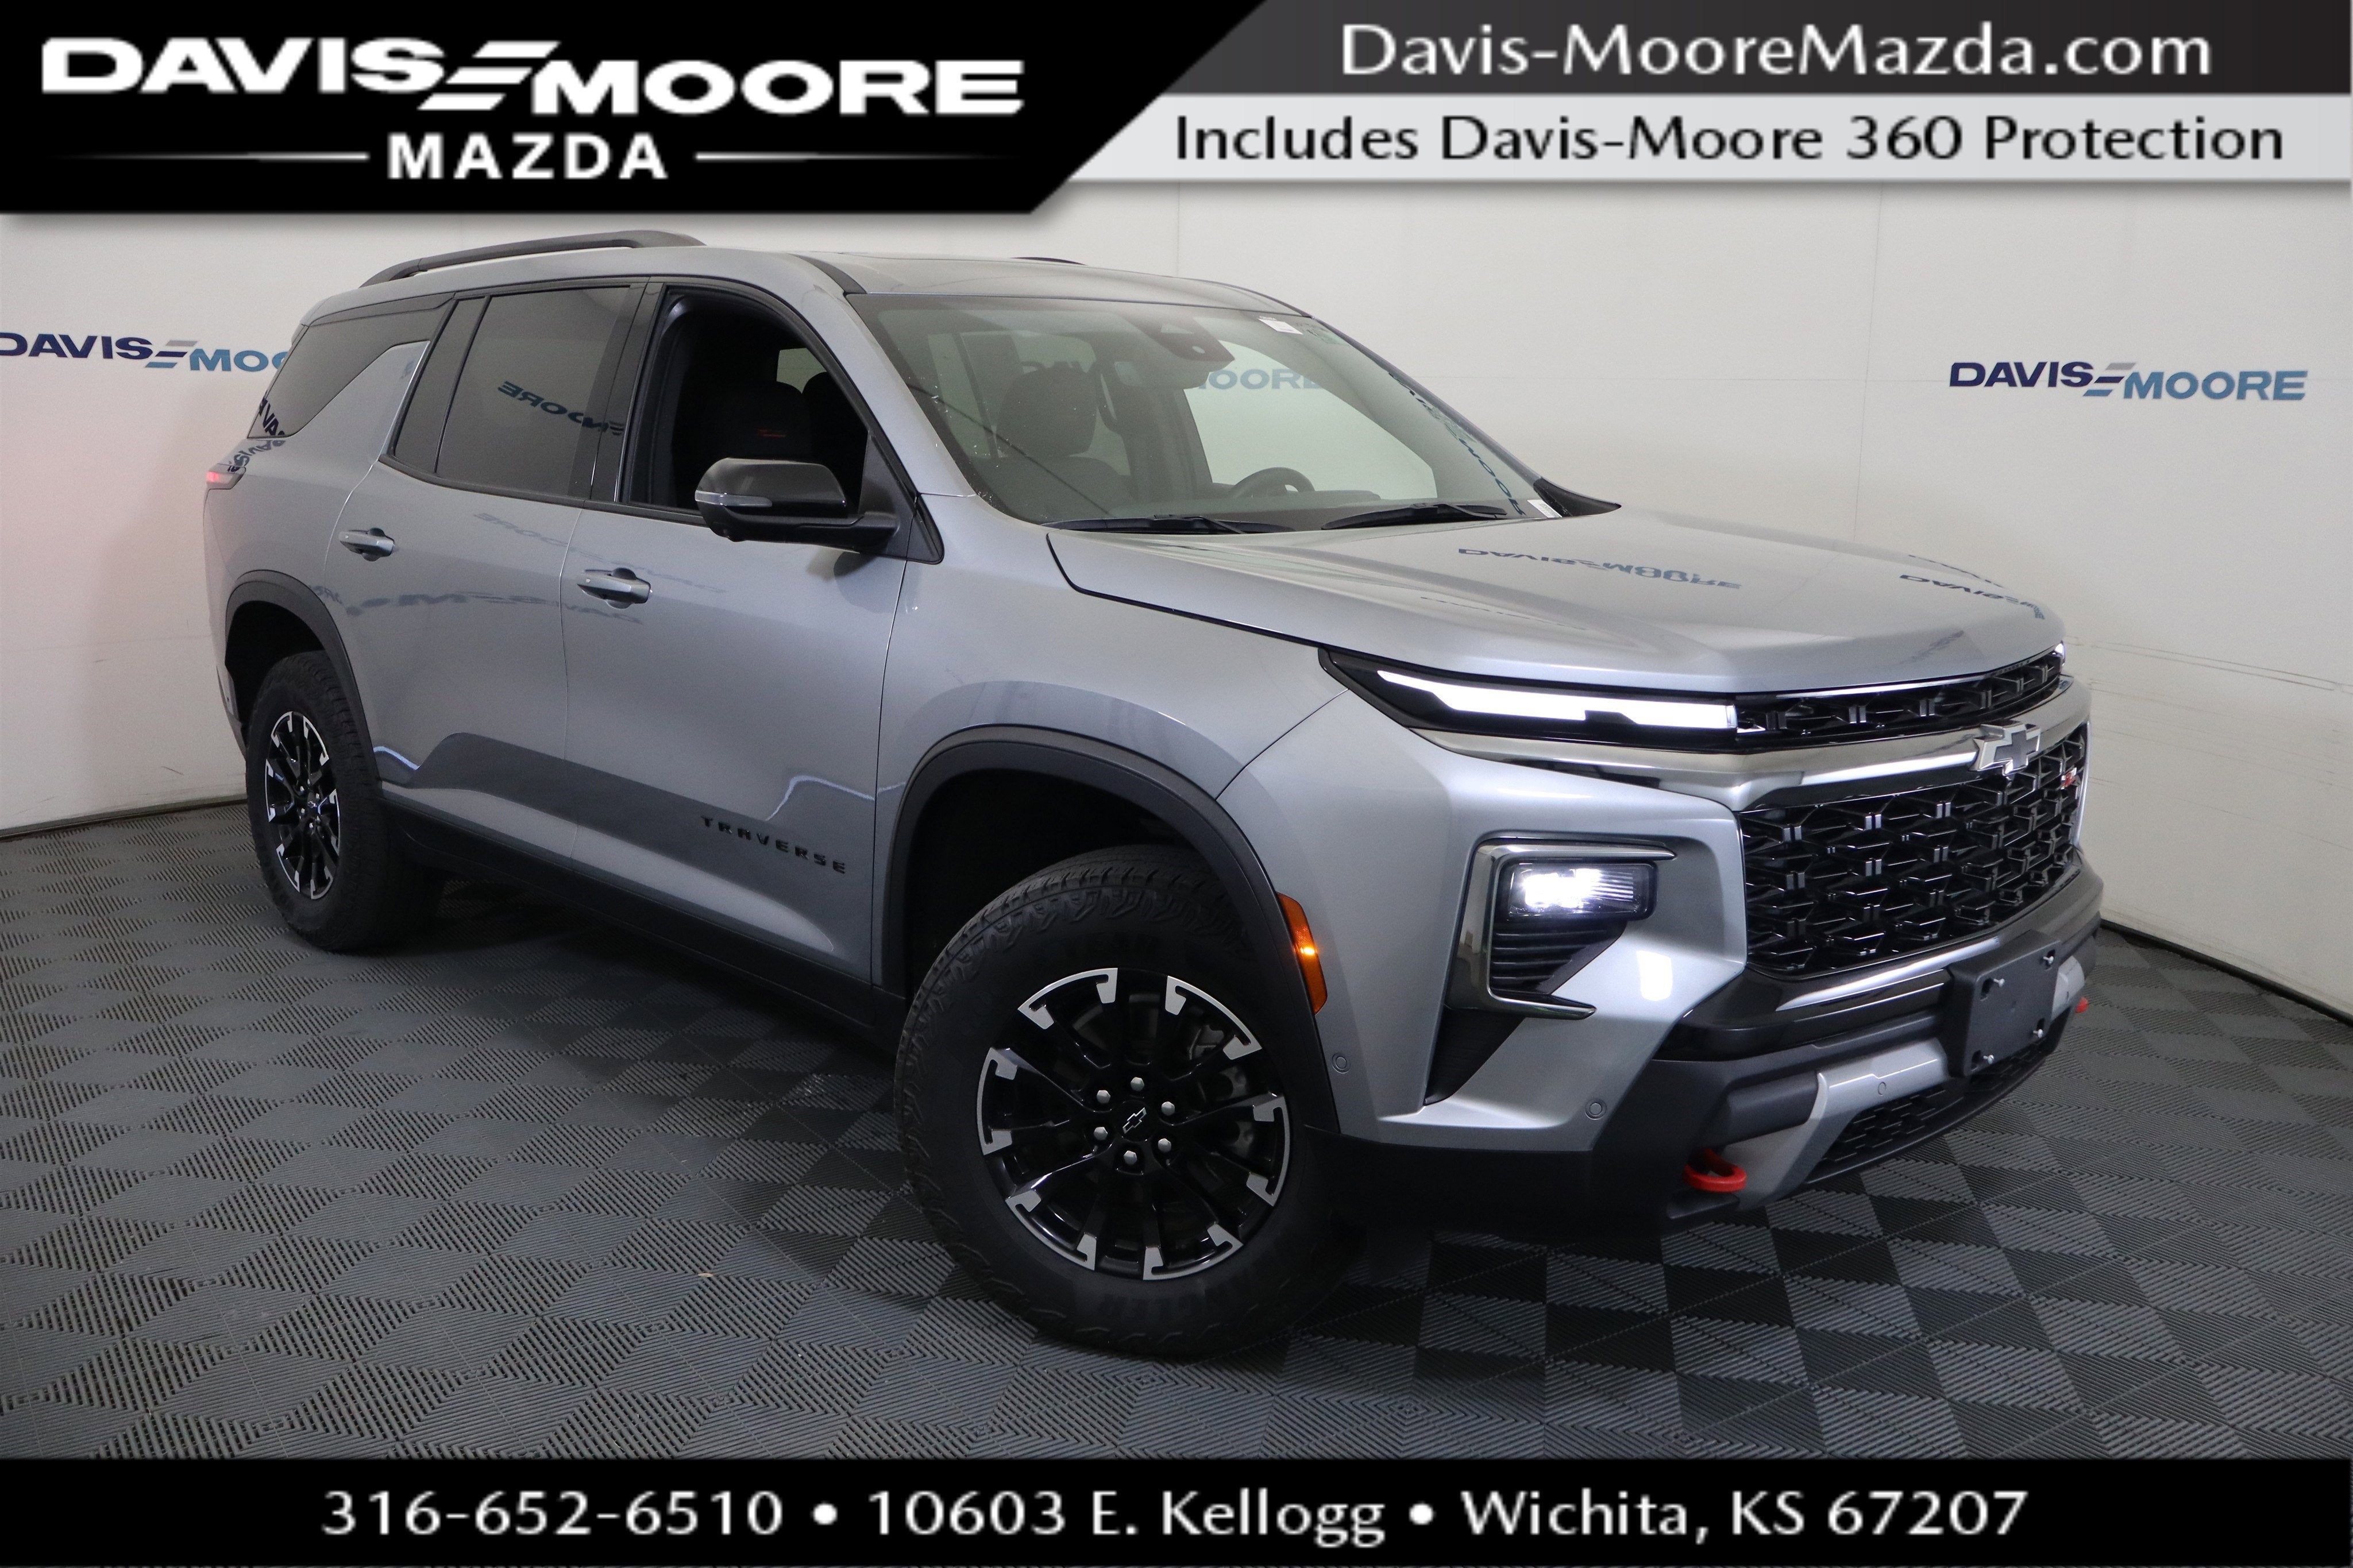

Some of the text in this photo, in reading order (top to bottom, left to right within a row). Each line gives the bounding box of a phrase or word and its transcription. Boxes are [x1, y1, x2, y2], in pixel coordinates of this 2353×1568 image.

[1949, 361, 2308, 400] DAVIS MOORE
[700, 815, 845, 874] TRAVERSE
